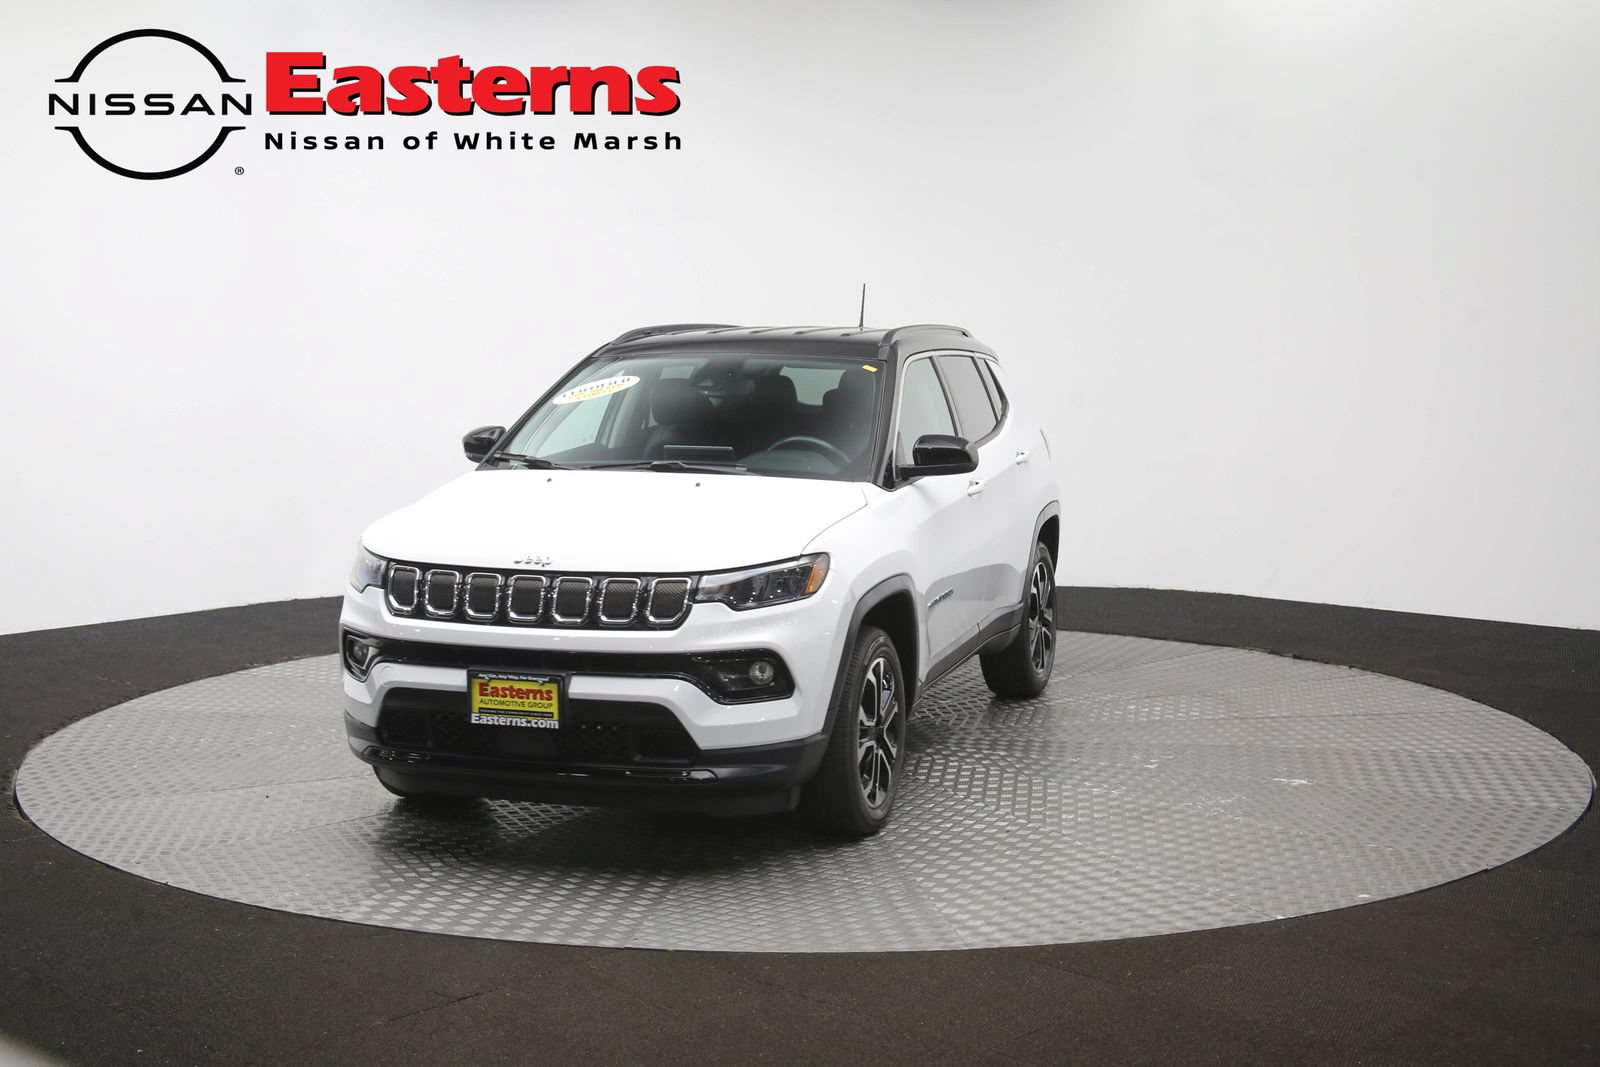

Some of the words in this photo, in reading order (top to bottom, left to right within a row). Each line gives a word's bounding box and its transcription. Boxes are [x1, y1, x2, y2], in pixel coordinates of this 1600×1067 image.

[513, 554, 552, 568] Jeep
[479, 681, 554, 701] Easterns
[480, 698, 526, 708] AUTOMOTIVE
[527, 701, 554, 710] GROUP
[471, 713, 560, 729] Easterns.com
